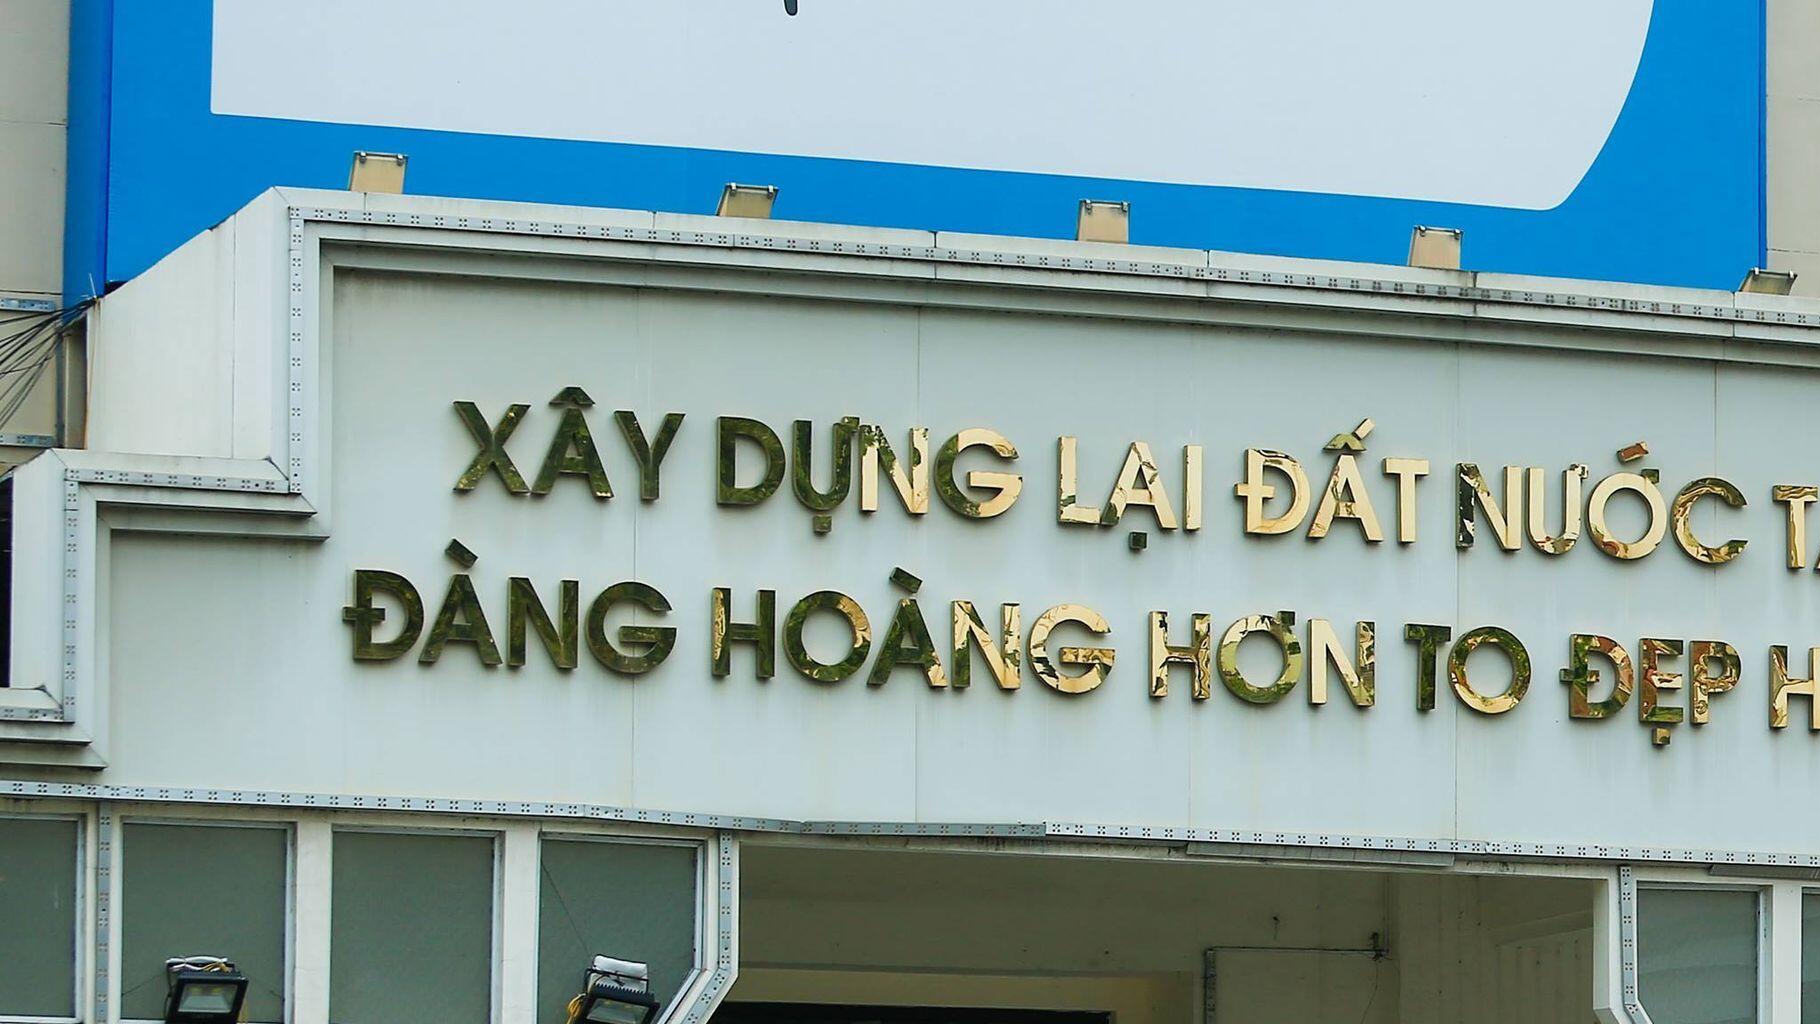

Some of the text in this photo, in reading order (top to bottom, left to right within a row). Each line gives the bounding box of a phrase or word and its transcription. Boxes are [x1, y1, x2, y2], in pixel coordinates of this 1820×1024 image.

[452, 386, 685, 501] XÂY
[716, 415, 1023, 534] DỰNG
[1057, 436, 1202, 551] LẠI
[1234, 417, 1429, 543] ĐẤT
[1456, 441, 1748, 565] NƯỚC
[342, 538, 677, 675] ĐÀNG
[711, 567, 1116, 695] HOÀNG
[1148, 610, 1376, 708] HƠN
[1404, 623, 1531, 715] TO
[1560, 633, 1742, 746] ĐẸP
